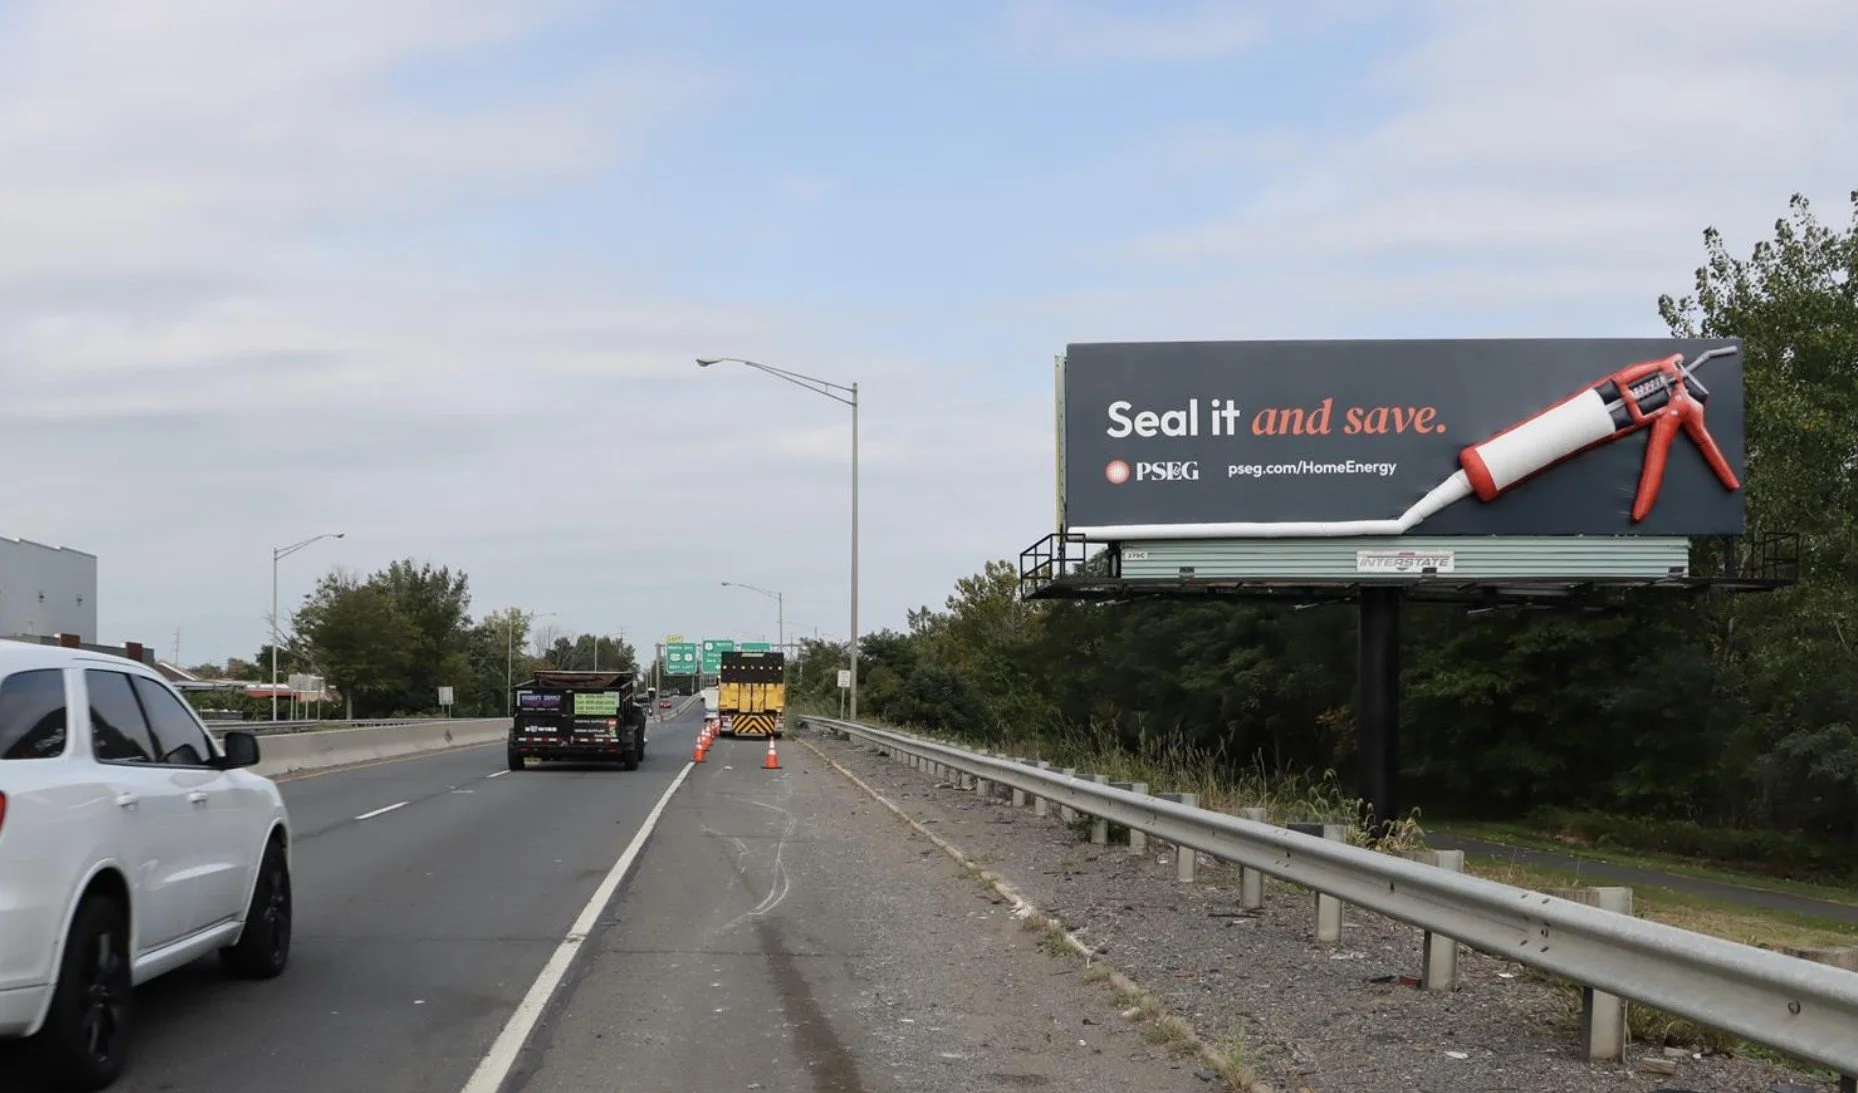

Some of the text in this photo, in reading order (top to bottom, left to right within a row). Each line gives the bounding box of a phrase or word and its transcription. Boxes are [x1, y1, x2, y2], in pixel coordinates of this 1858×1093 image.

[1106, 397, 1447, 438] Seal it and save.
[1228, 460, 1398, 478] pseg.com/HomeEnergy
[1359, 558, 1450, 568] INTERSTATE
